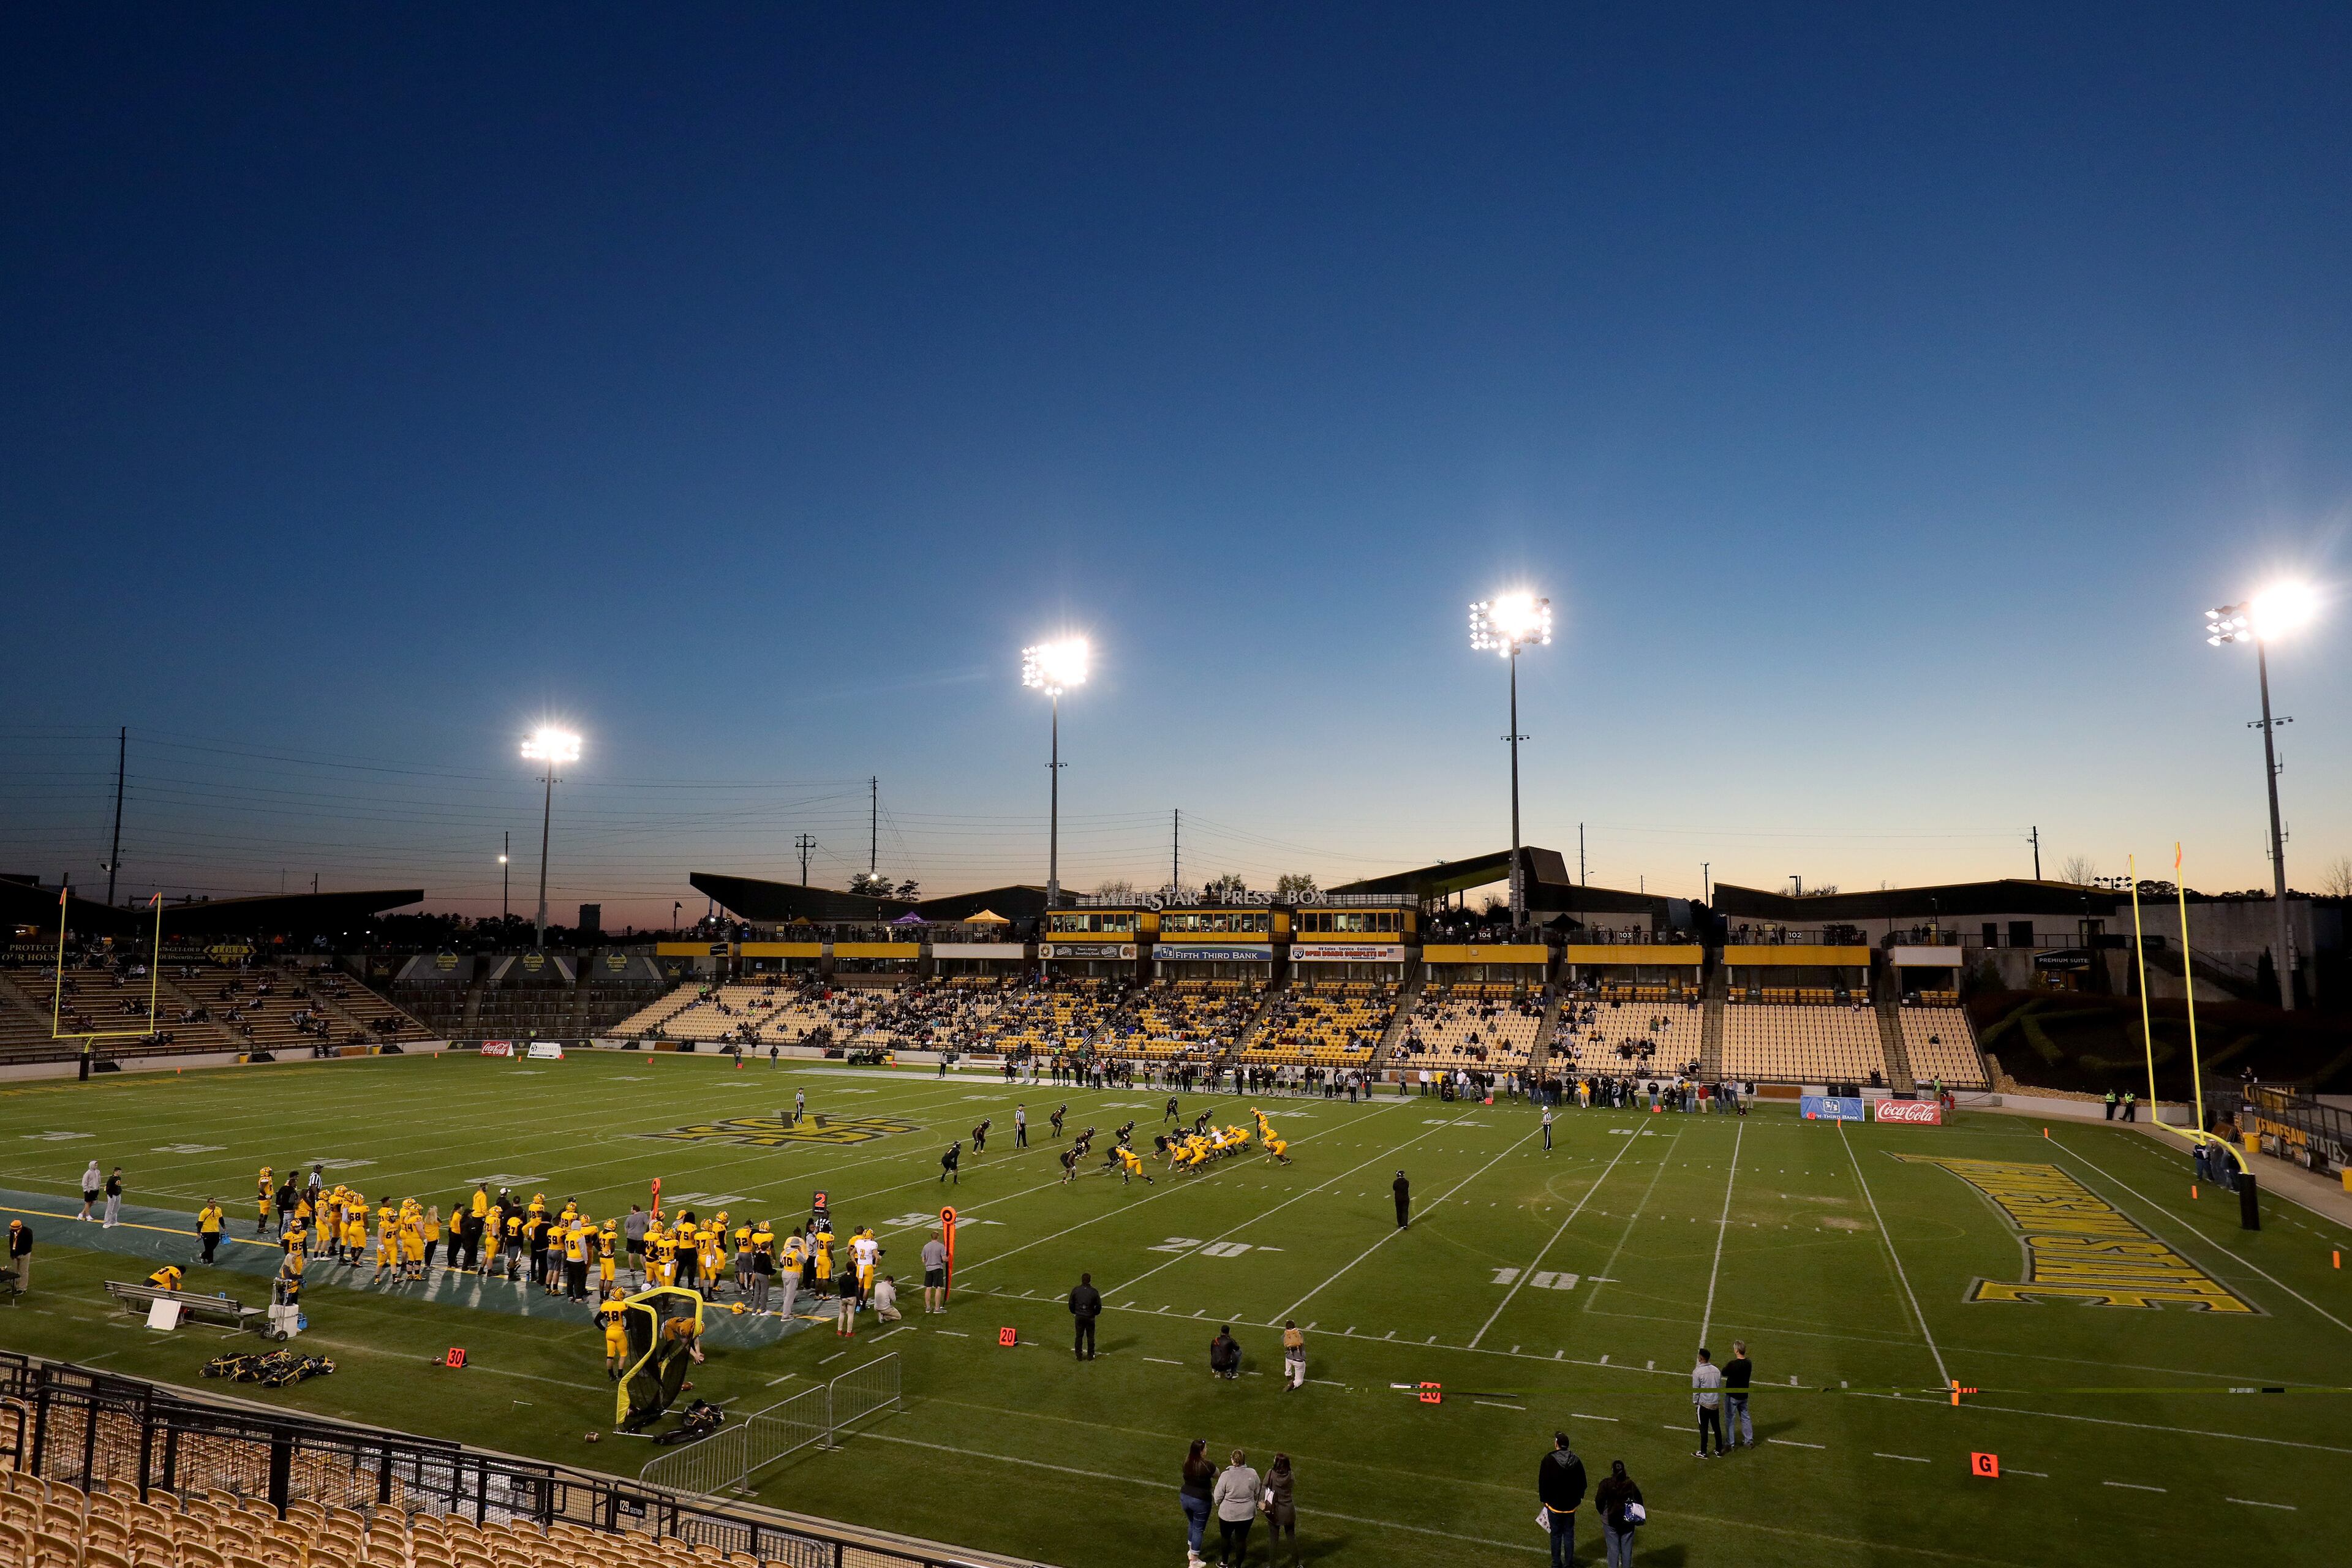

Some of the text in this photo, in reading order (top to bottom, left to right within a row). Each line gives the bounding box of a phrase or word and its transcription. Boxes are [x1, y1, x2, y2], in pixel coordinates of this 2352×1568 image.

[1221, 890, 1272, 905] PRESS
[1287, 889, 1327, 905] BOX
[1175, 951, 1257, 960] FIFTH THIRD BANK
[1877, 1102, 1937, 1122] Coca-Cola
[2255, 1117, 2307, 1145] KENNESAW
[2306, 1133, 2341, 1162] STATE
[815, 1193, 826, 1207] 2
[350, 1212, 361, 1221] 68
[677, 1231, 688, 1240] 75
[736, 1237, 748, 1246] 32
[291, 1243, 303, 1251] 85
[658, 1247, 669, 1256] 21
[817, 1240, 824, 1250] 16
[1147, 1237, 1253, 1258] 20
[783, 1256, 793, 1267] 10
[859, 1249, 866, 1260] 2
[1490, 1267, 1580, 1291] 10
[603, 1311, 619, 1321] 88
[1001, 1329, 1014, 1343] 20
[449, 1349, 462, 1365] 30
[1422, 1384, 1439, 1400] 10
[1978, 1455, 1992, 1473] G
[526, 1480, 535, 1493] 128
[619, 1499, 643, 1515] 129 SECTION
